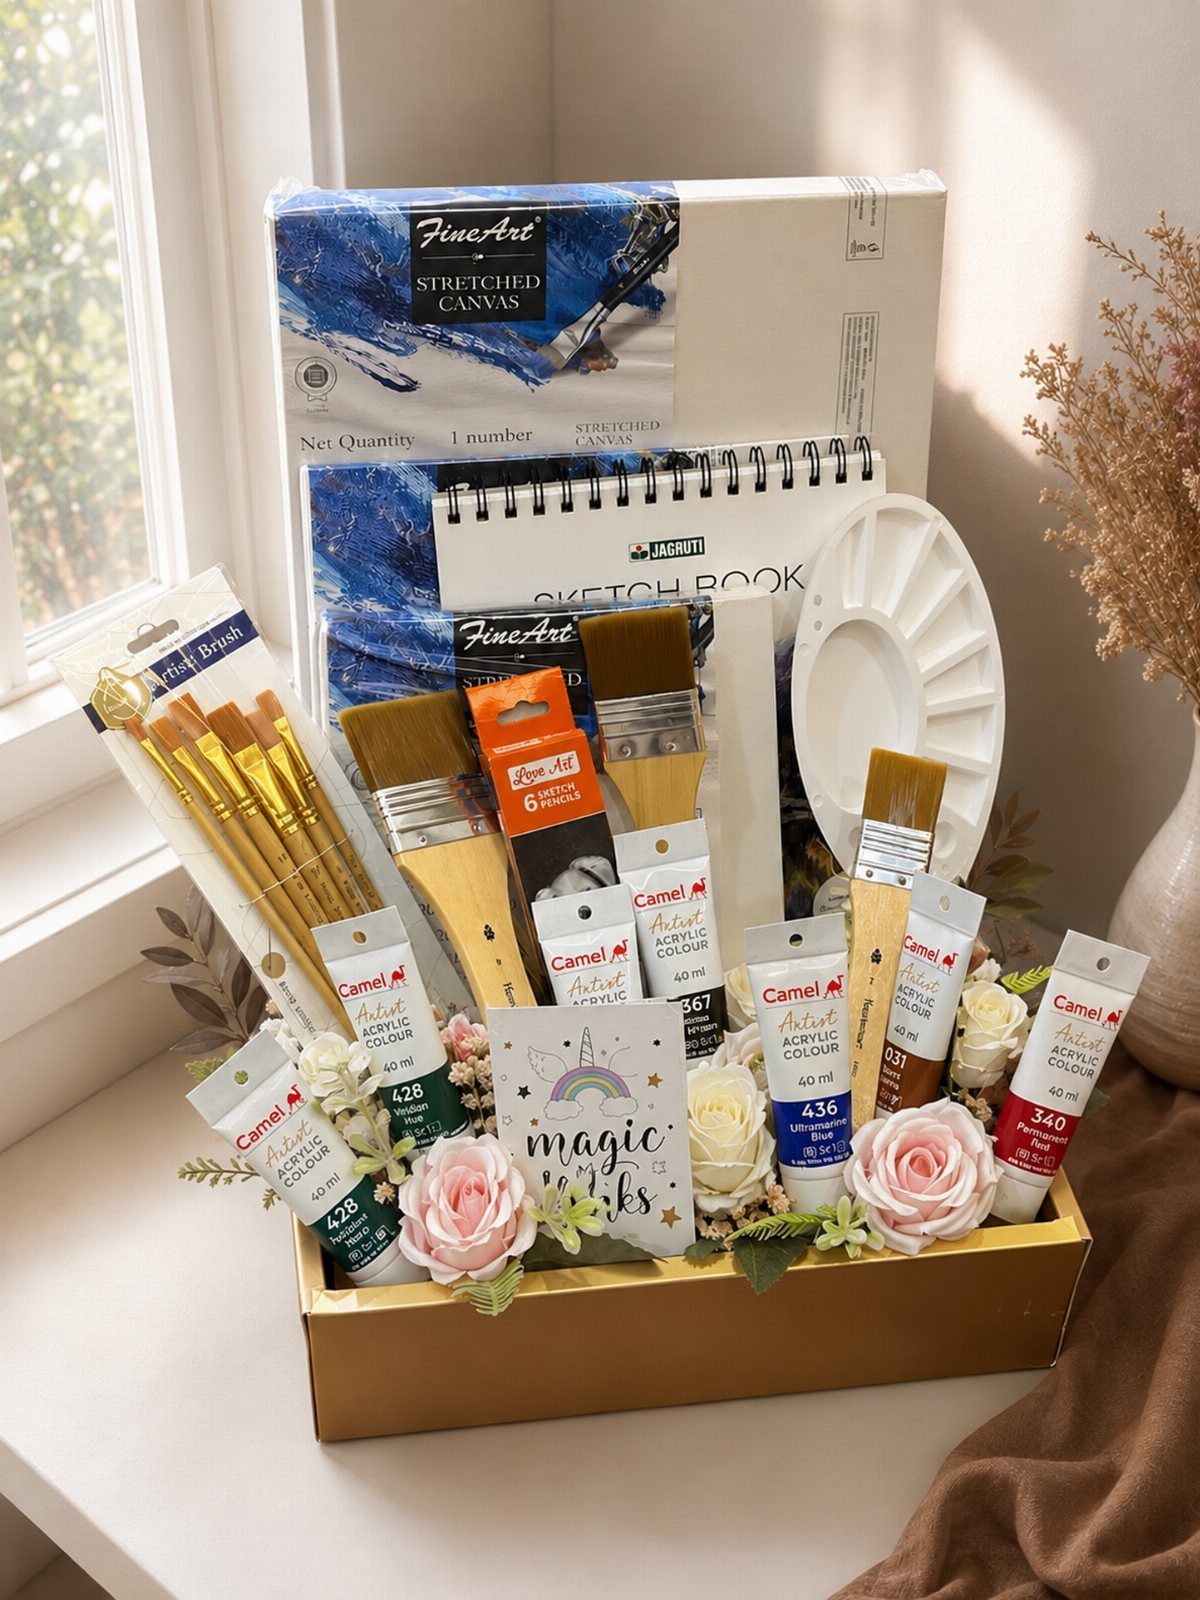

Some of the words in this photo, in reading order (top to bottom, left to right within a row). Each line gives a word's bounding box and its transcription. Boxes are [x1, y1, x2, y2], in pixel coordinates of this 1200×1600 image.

[416, 274, 541, 292] STRETCHED
[439, 294, 520, 312] CANVAS
[451, 430, 458, 445] 1
[465, 429, 533, 445] number
[575, 420, 661, 435] STRETCHED
[300, 435, 333, 451] Net
[339, 434, 416, 452] Quantity
[575, 434, 633, 447] CANVAS
[651, 539, 704, 558] JAGRUTI
[696, 564, 805, 592] BOOK
[459, 618, 574, 651] FineArt
[152, 657, 196, 692] rtis
[198, 625, 244, 661] Brush
[513, 766, 545, 786] Love
[538, 782, 576, 800] SKETCH
[541, 791, 582, 809] PENCILS
[524, 794, 538, 812] 6
[634, 885, 685, 908] Camel
[655, 927, 707, 947] ACRYLIC
[657, 940, 709, 959] COLOUR
[904, 935, 939, 962] Camel
[551, 947, 606, 971] Camel
[674, 972, 689, 983] 40
[692, 967, 706, 978] ml
[338, 973, 387, 998] Camel
[763, 981, 820, 1004] Camel
[682, 994, 711, 1014] 367
[897, 984, 935, 1008] ACRYLIC
[895, 995, 932, 1020] COLOUR
[1054, 994, 1103, 1021] Camel
[363, 1017, 410, 1037] ACRYLIC
[894, 1024, 906, 1037] 40
[906, 1031, 919, 1043] ml
[366, 1029, 413, 1049] COLOUR
[783, 1030, 838, 1047] ACRYLIC
[783, 1043, 840, 1060] COLOUR
[884, 1050, 907, 1068] 031
[1051, 1045, 1099, 1066] ACRYLIC
[383, 1062, 398, 1073] 40
[400, 1055, 415, 1068] ml
[1048, 1056, 1095, 1079] COLOUR
[798, 1076, 815, 1087] 40
[818, 1072, 834, 1083] ml
[392, 1083, 424, 1103] 428
[1048, 1086, 1063, 1098] 40
[1066, 1090, 1079, 1102] ml
[802, 1100, 838, 1118] 436
[236, 1104, 286, 1151] Camel
[1031, 1108, 1067, 1131] 340
[277, 1135, 323, 1180] ACRYLIC
[527, 1119, 666, 1176] magic
[283, 1144, 330, 1188] COLOUR
[311, 1186, 326, 1202] 40
[325, 1172, 341, 1191] ml
[326, 1198, 359, 1231] 428
